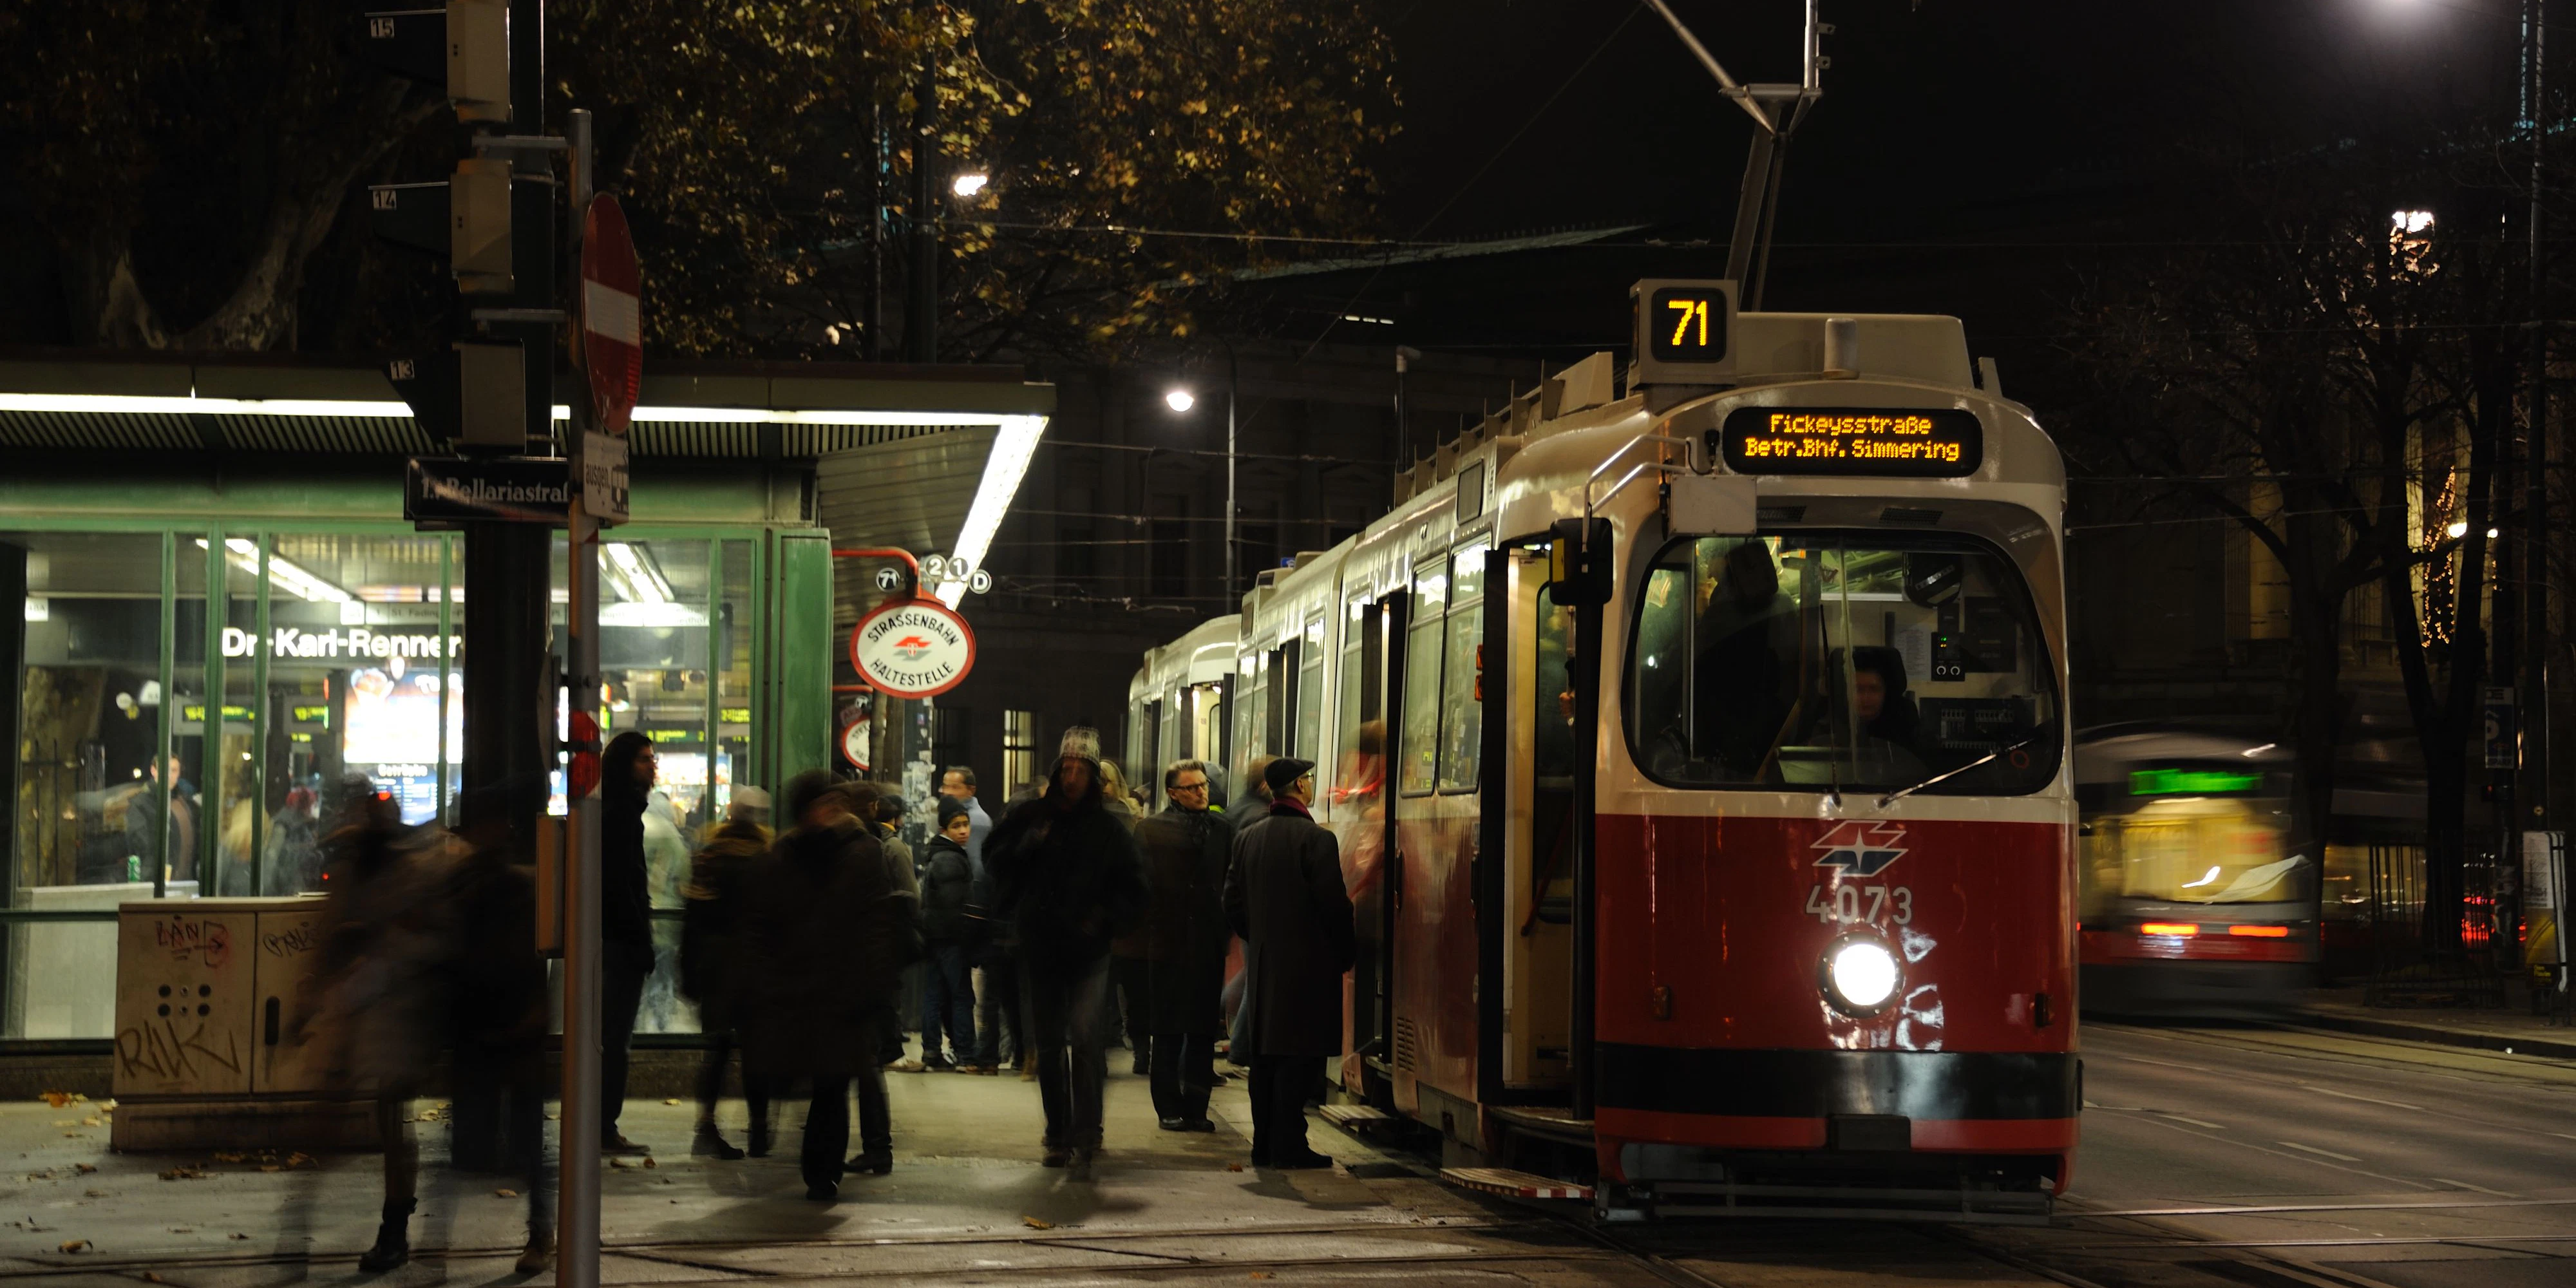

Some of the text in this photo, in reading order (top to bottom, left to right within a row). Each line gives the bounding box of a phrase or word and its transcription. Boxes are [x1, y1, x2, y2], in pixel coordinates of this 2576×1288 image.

[372, 17, 393, 37] 15
[375, 191, 396, 209] 14
[1668, 300, 1707, 346] 71
[392, 361, 413, 380] 13
[1770, 414, 1932, 437] Fickeysstraße
[1852, 439, 1960, 462] Simmering
[929, 561, 962, 575] 2 1
[880, 572, 897, 589] 71
[975, 574, 987, 589] D
[868, 614, 960, 647] STRASSENBAHN
[222, 627, 462, 658] Dr-Karl-Renner
[870, 658, 954, 687] HALTESTELLE
[1806, 884, 1912, 924] 4073
